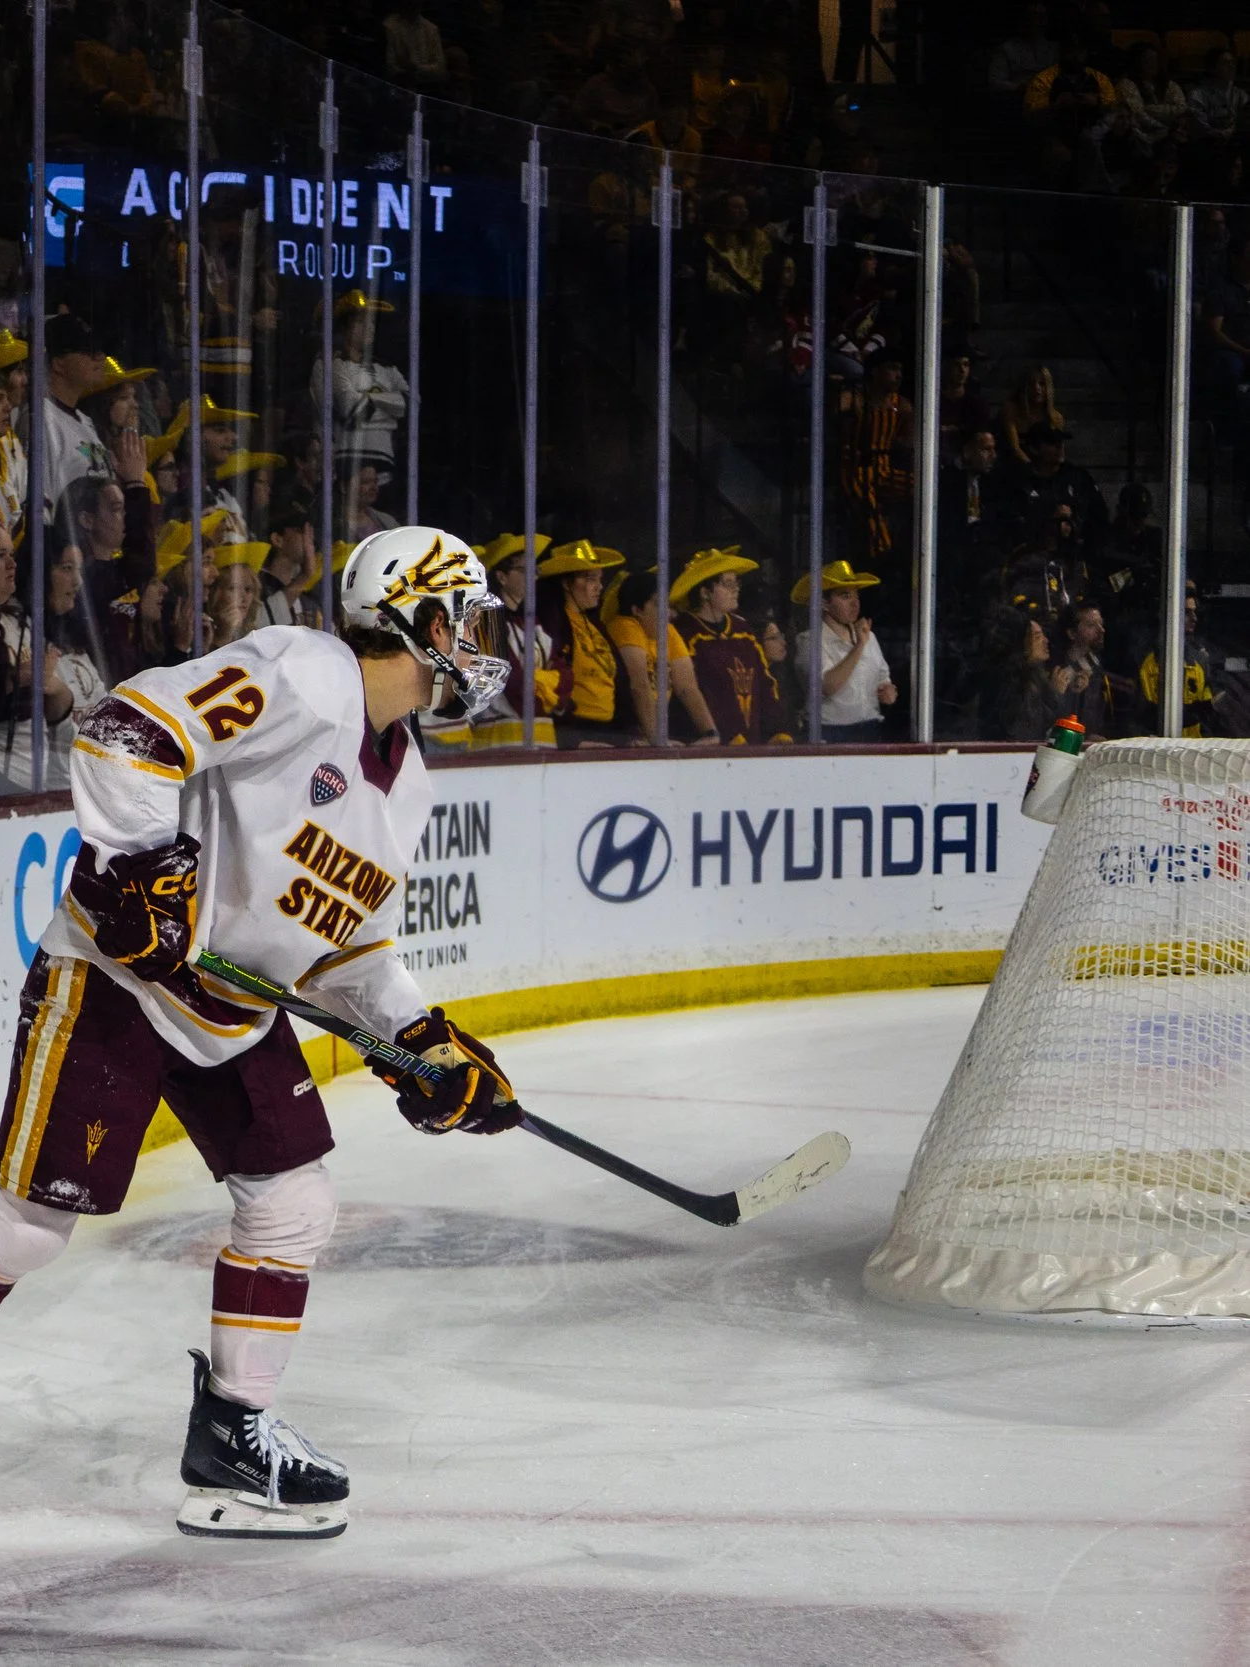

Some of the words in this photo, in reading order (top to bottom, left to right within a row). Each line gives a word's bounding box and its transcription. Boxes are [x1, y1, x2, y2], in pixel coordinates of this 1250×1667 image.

[425, 646, 455, 673] CCM
[184, 665, 266, 742] 12
[315, 767, 345, 795] NCHC
[282, 818, 398, 915] ARIZON
[692, 802, 998, 888] HYUNDAI
[398, 871, 482, 937] ERICA
[427, 943, 468, 969] UNION
